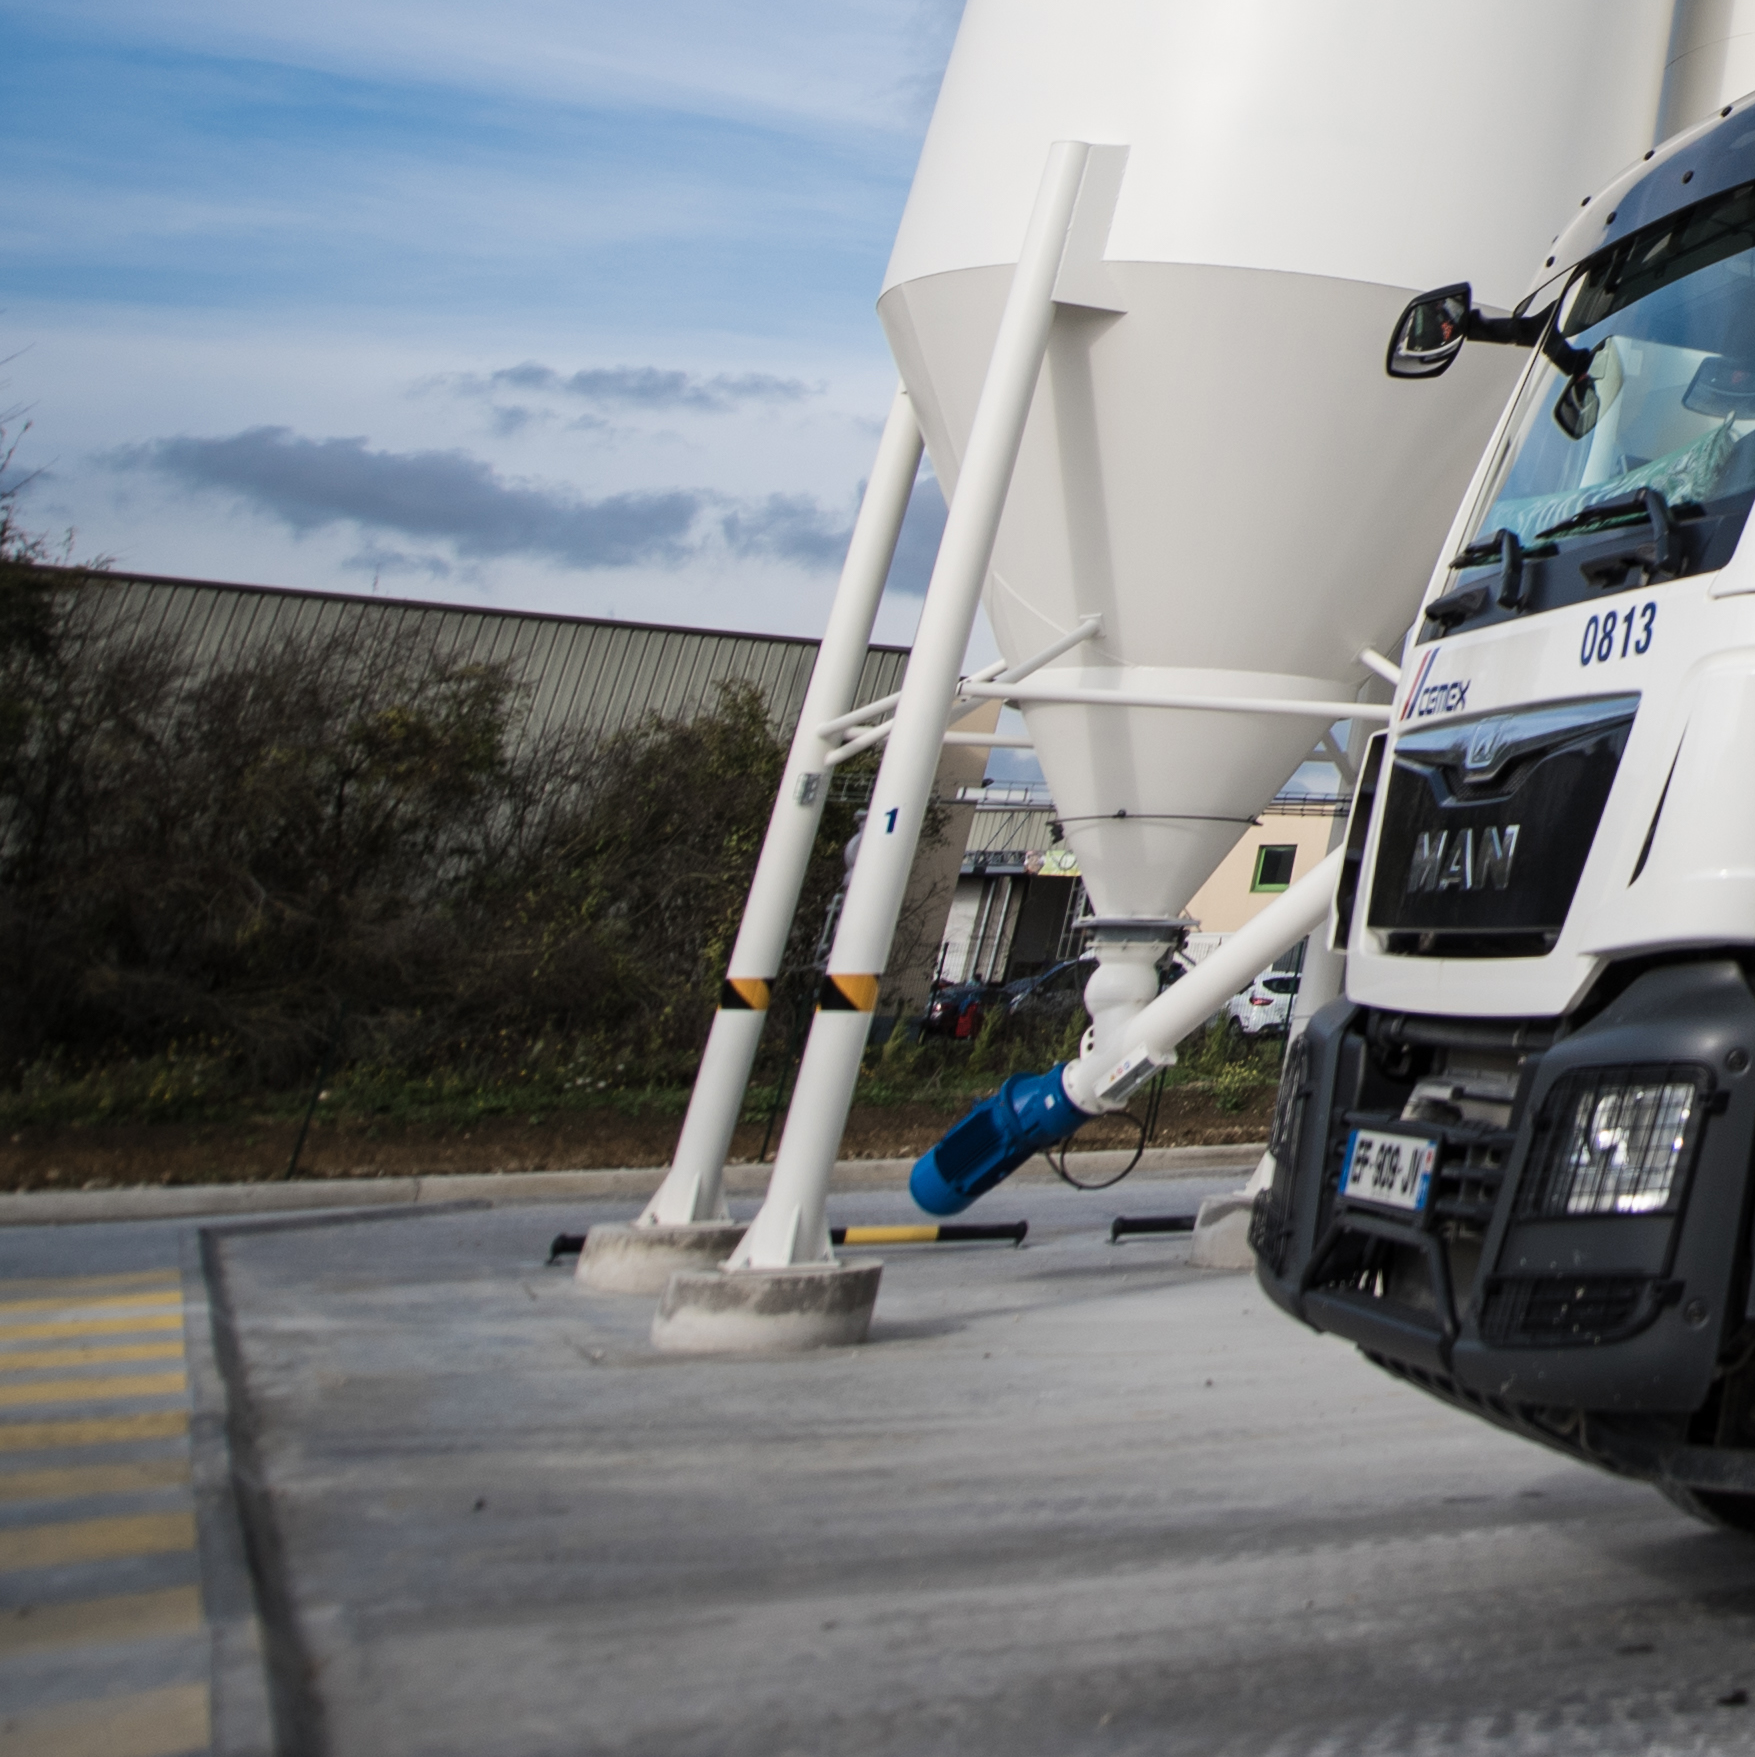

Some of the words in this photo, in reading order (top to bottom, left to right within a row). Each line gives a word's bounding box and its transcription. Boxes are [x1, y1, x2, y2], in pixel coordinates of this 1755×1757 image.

[1580, 601, 1657, 667] 0813
[1417, 679, 1472, 717] CEMEX
[884, 806, 900, 835] 1
[1406, 823, 1521, 893] MAN
